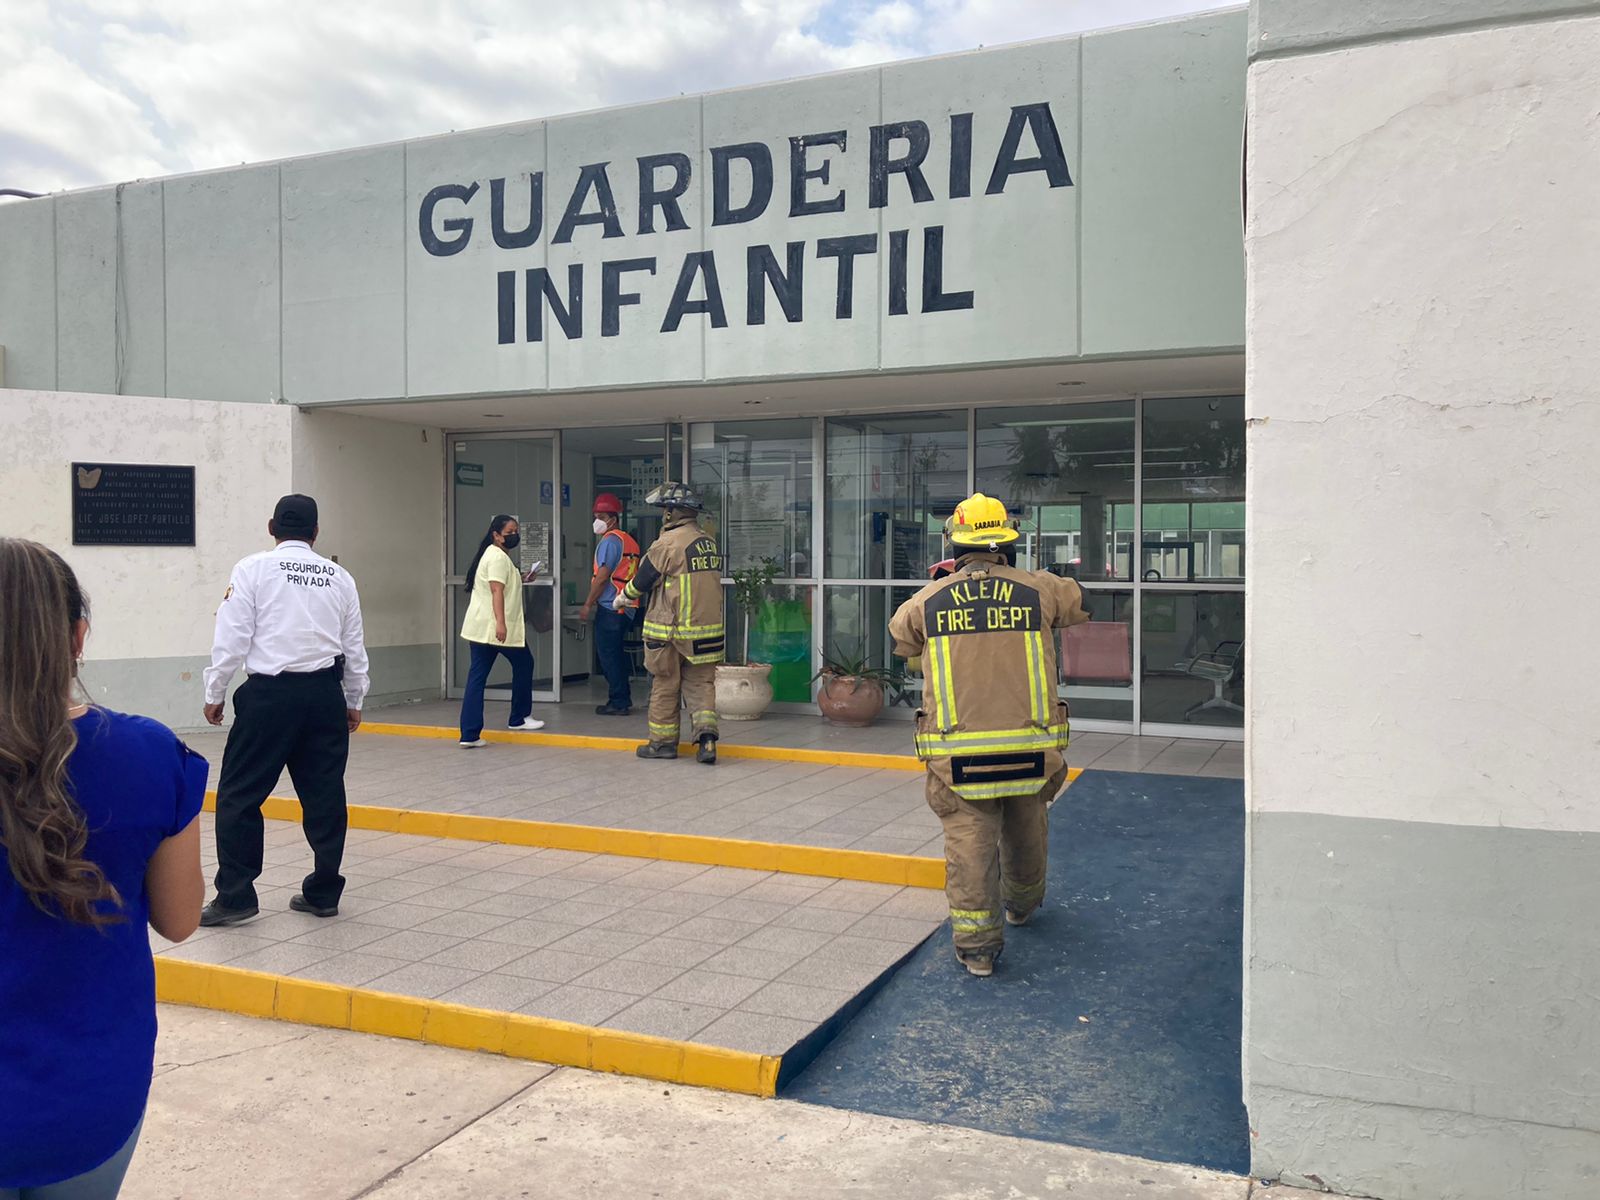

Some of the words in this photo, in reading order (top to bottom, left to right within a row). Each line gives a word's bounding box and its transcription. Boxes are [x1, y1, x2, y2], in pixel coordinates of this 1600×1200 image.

[418, 101, 1074, 257] GUARDERIA
[497, 225, 975, 345] INFANTIL
[974, 520, 1000, 530] SARABIA
[280, 562, 335, 576] SEGURIDAD
[691, 556, 708, 570] FIRE
[287, 574, 331, 587] PRIVADA
[950, 580, 1014, 605] KLEIN
[936, 608, 976, 633] FIRE
[986, 606, 1032, 630] DEPT
